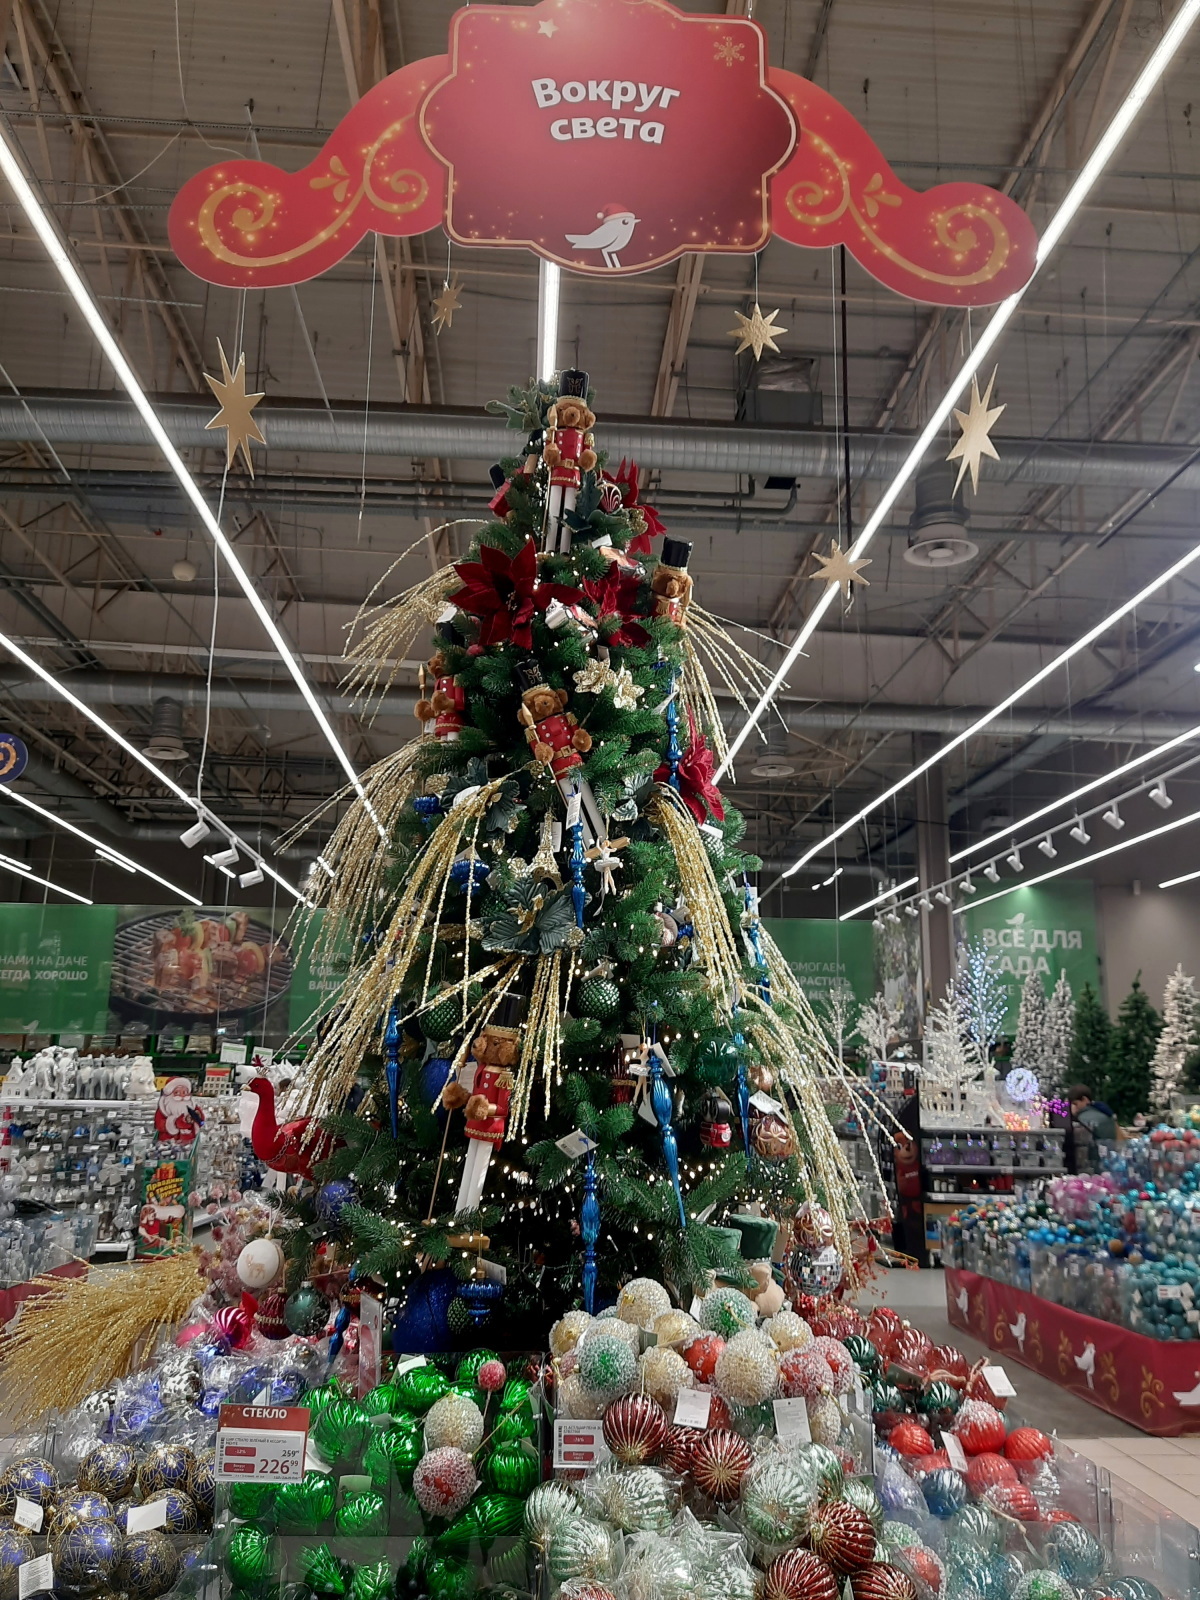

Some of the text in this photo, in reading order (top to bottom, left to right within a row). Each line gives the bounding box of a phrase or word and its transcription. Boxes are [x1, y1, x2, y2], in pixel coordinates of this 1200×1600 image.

[531, 77, 680, 112] Вокруг
[550, 116, 665, 144] света
[1030, 929, 1082, 953] ДЛЯ
[36, 955, 53, 966] НА
[54, 955, 88, 968] ДАЧЕ
[984, 955, 1051, 979] САДА
[0, 969, 89, 982] ЕГДА ХОРОШО
[242, 1407, 287, 1419] СТЕКЛО
[259, 1459, 289, 1475] 226
